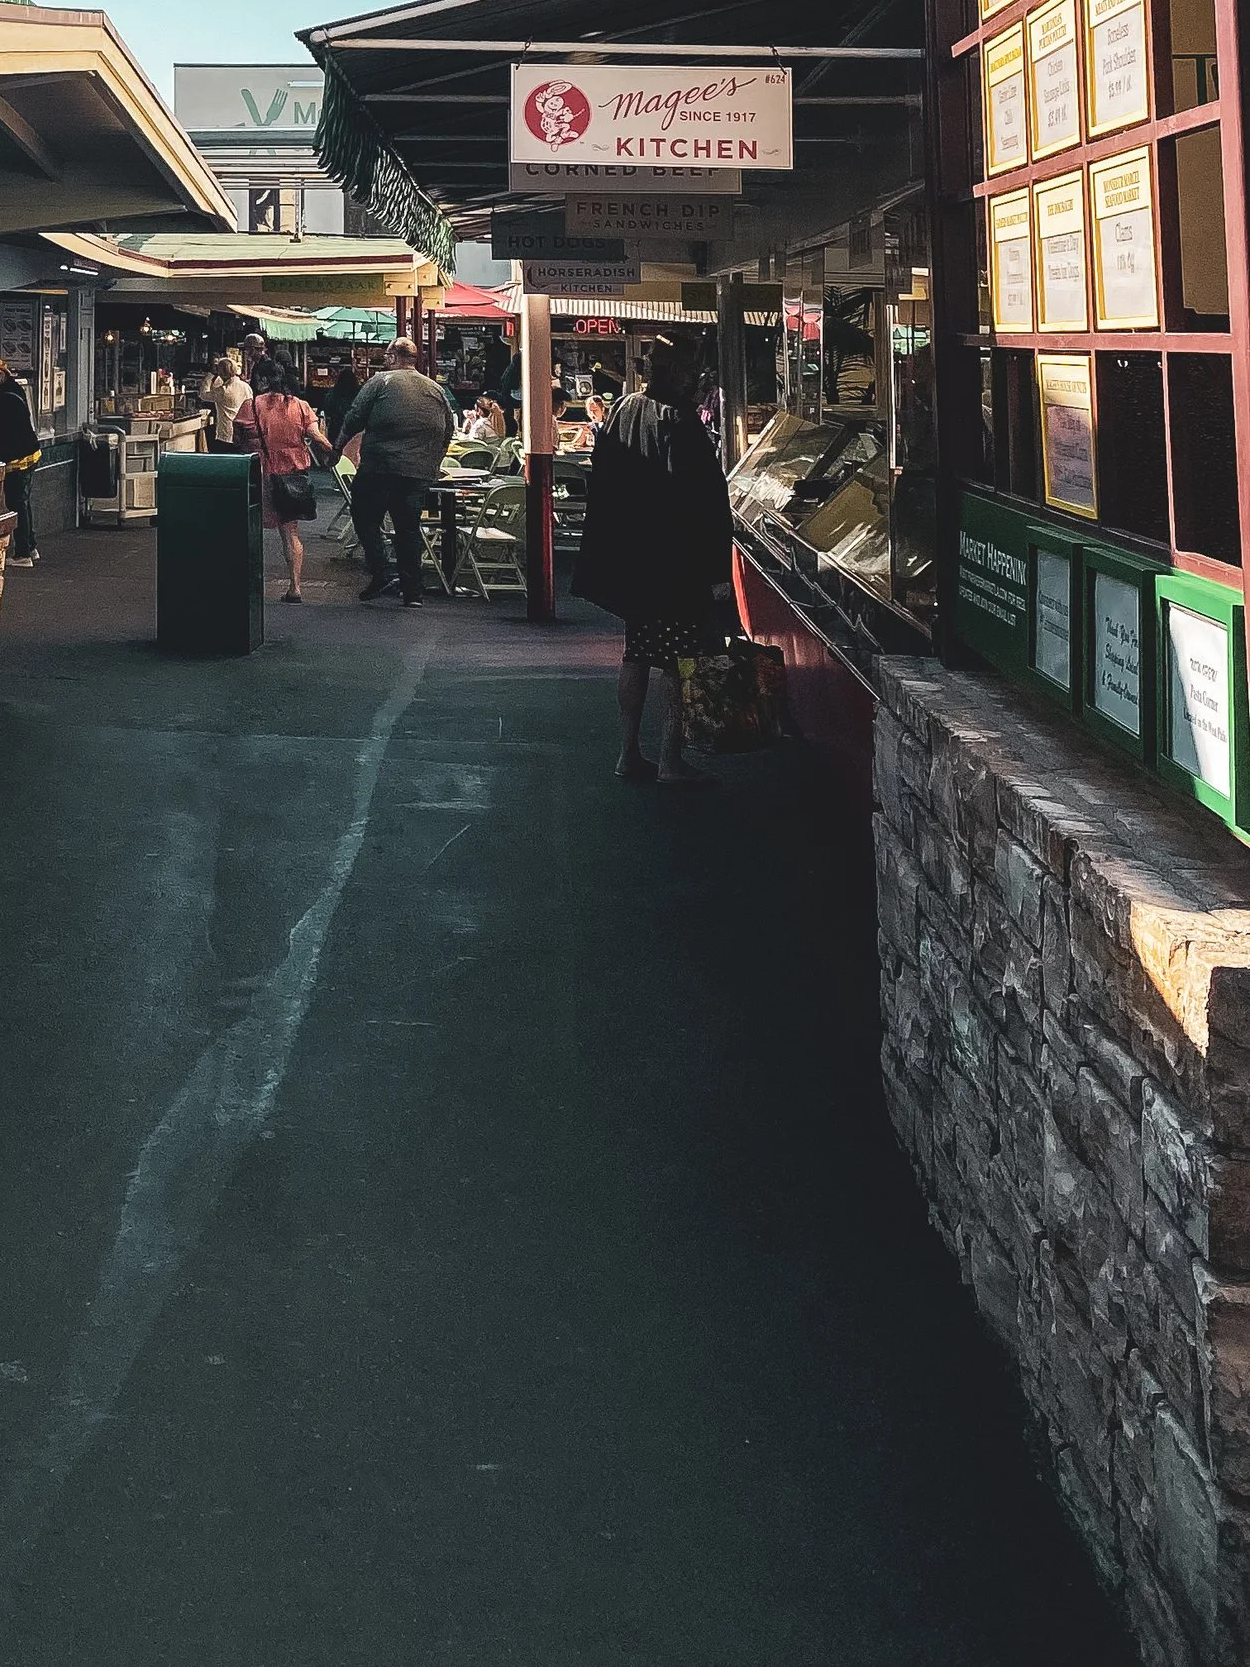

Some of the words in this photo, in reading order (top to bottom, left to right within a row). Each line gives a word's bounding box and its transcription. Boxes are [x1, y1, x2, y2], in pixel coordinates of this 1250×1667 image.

[764, 74, 786, 85] #624
[598, 76, 758, 131] Magee's
[679, 110, 721, 123] SINCE
[726, 112, 757, 123] 1917
[616, 137, 758, 160] KITCHEN
[526, 165, 638, 177] CORNED
[652, 166, 721, 178] BEEF
[576, 201, 669, 218] FRENCH
[681, 203, 721, 219] DIP
[592, 219, 705, 232] SANDWICHES
[507, 234, 544, 249] HOT
[537, 267, 636, 278] HORSERADISH
[318, 279, 375, 290] BAZAAR
[559, 283, 613, 293] KITCHEN
[575, 318, 621, 335] OPEN
[959, 530, 986, 566] MARKET
